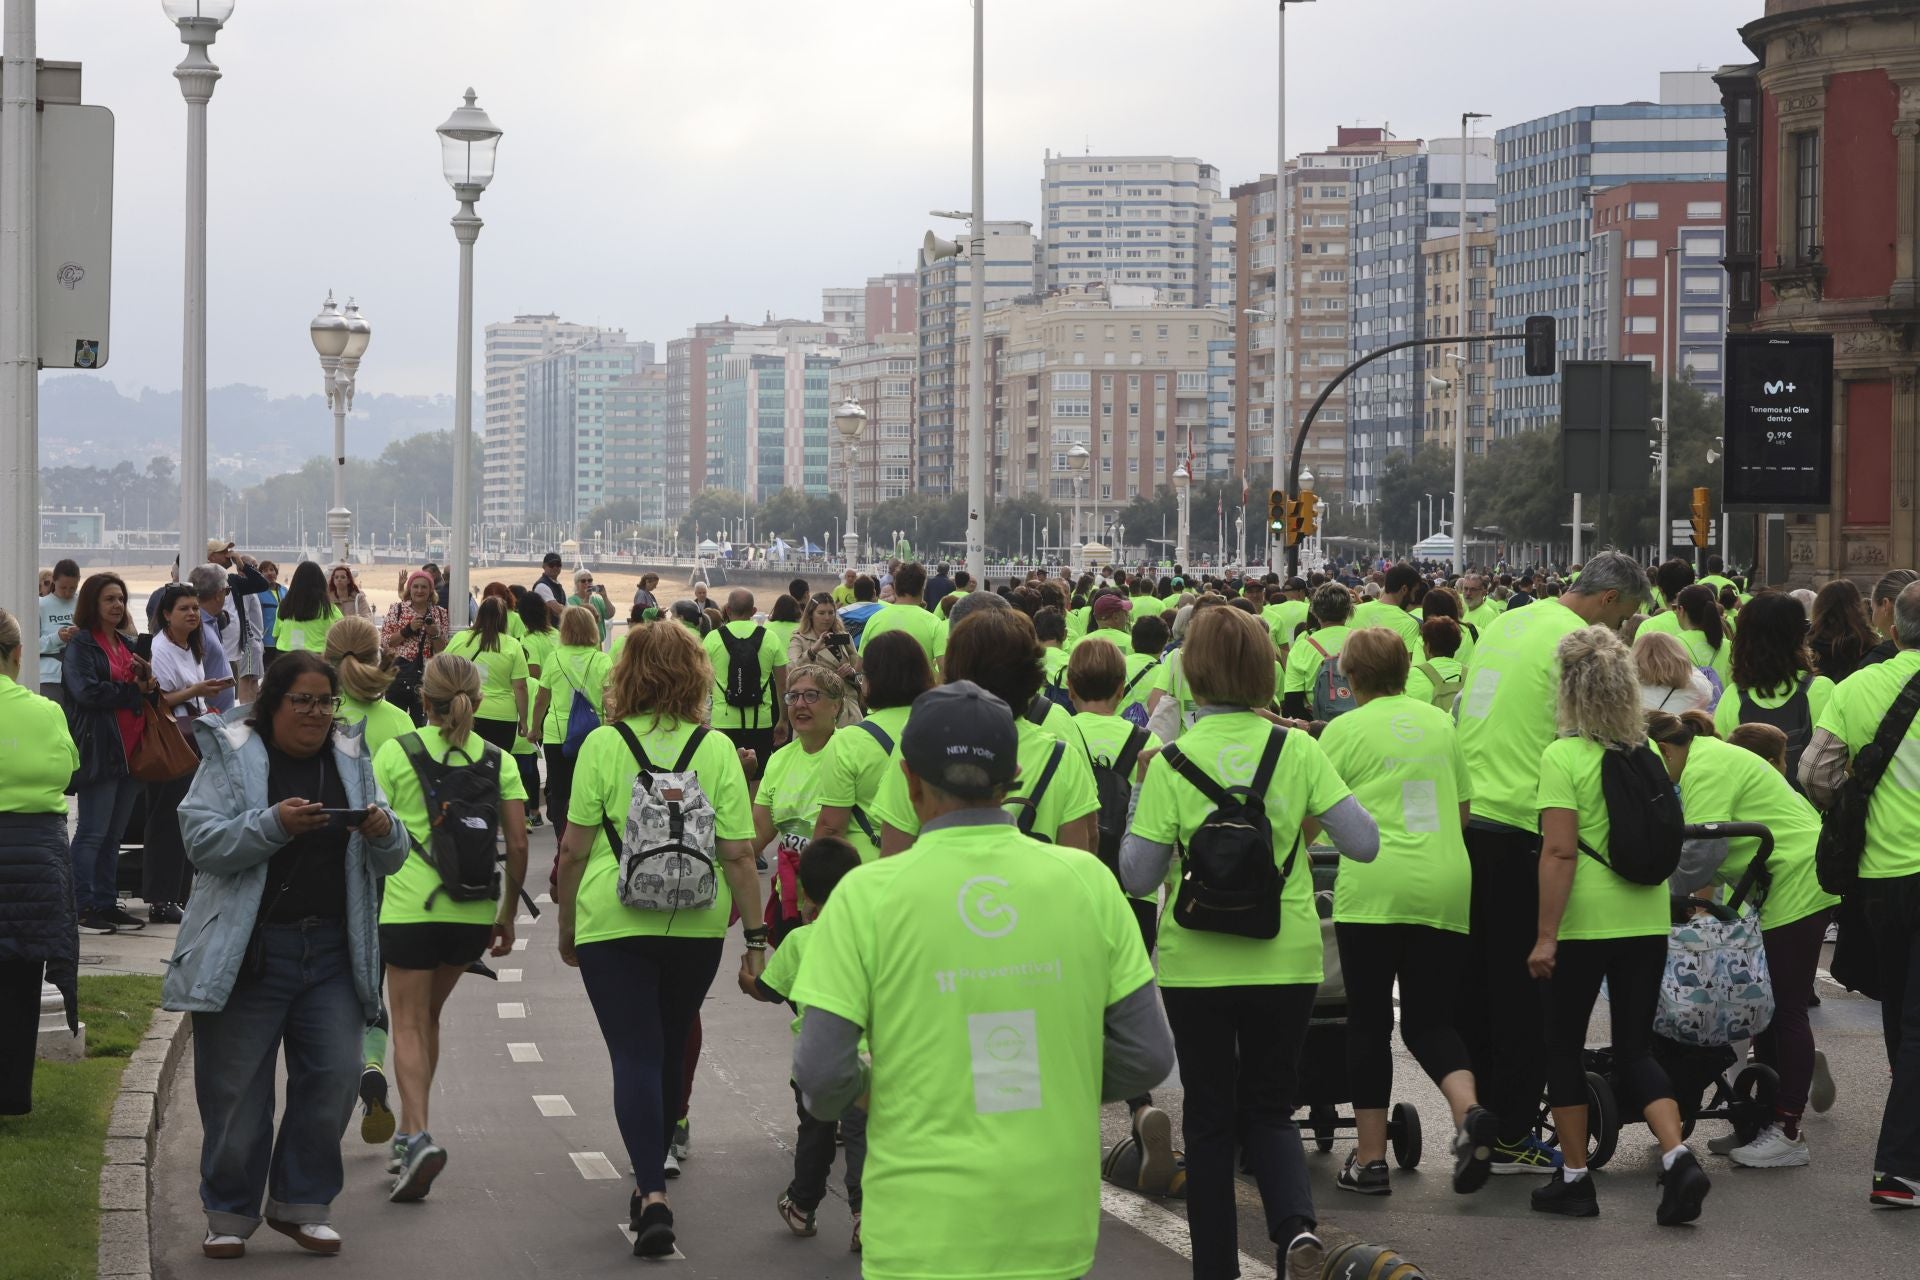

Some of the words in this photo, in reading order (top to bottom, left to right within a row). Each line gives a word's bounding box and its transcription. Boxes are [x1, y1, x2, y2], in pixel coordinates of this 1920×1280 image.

[1750, 406, 1782, 414] Tenemos
[1784, 406, 1791, 414] el
[1792, 406, 1810, 414] Cine
[946, 745, 969, 756] NEW
[972, 747, 996, 761] YORK
[959, 961, 1053, 982] Preventiva
